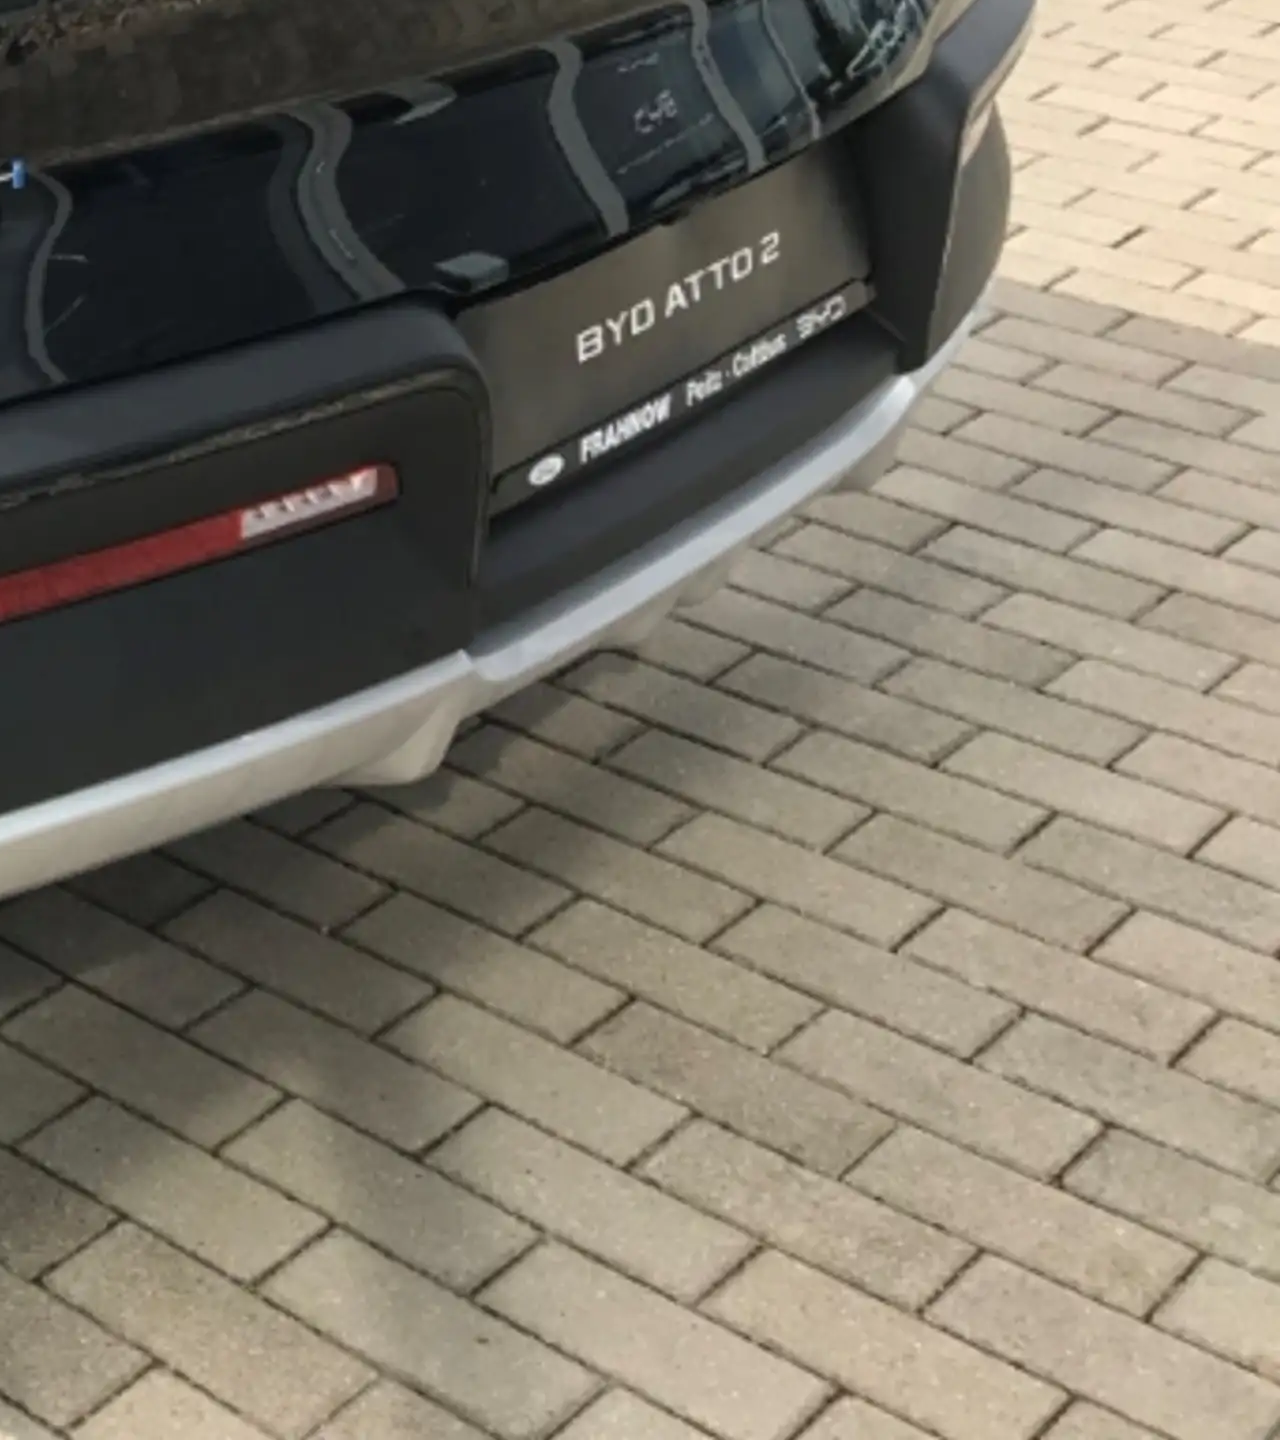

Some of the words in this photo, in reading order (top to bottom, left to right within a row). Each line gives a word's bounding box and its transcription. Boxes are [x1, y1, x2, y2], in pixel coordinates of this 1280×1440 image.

[576, 298, 656, 363] BYD
[665, 247, 753, 318] ATTO
[759, 230, 780, 264] 2
[580, 393, 671, 464] FRAHNOW
